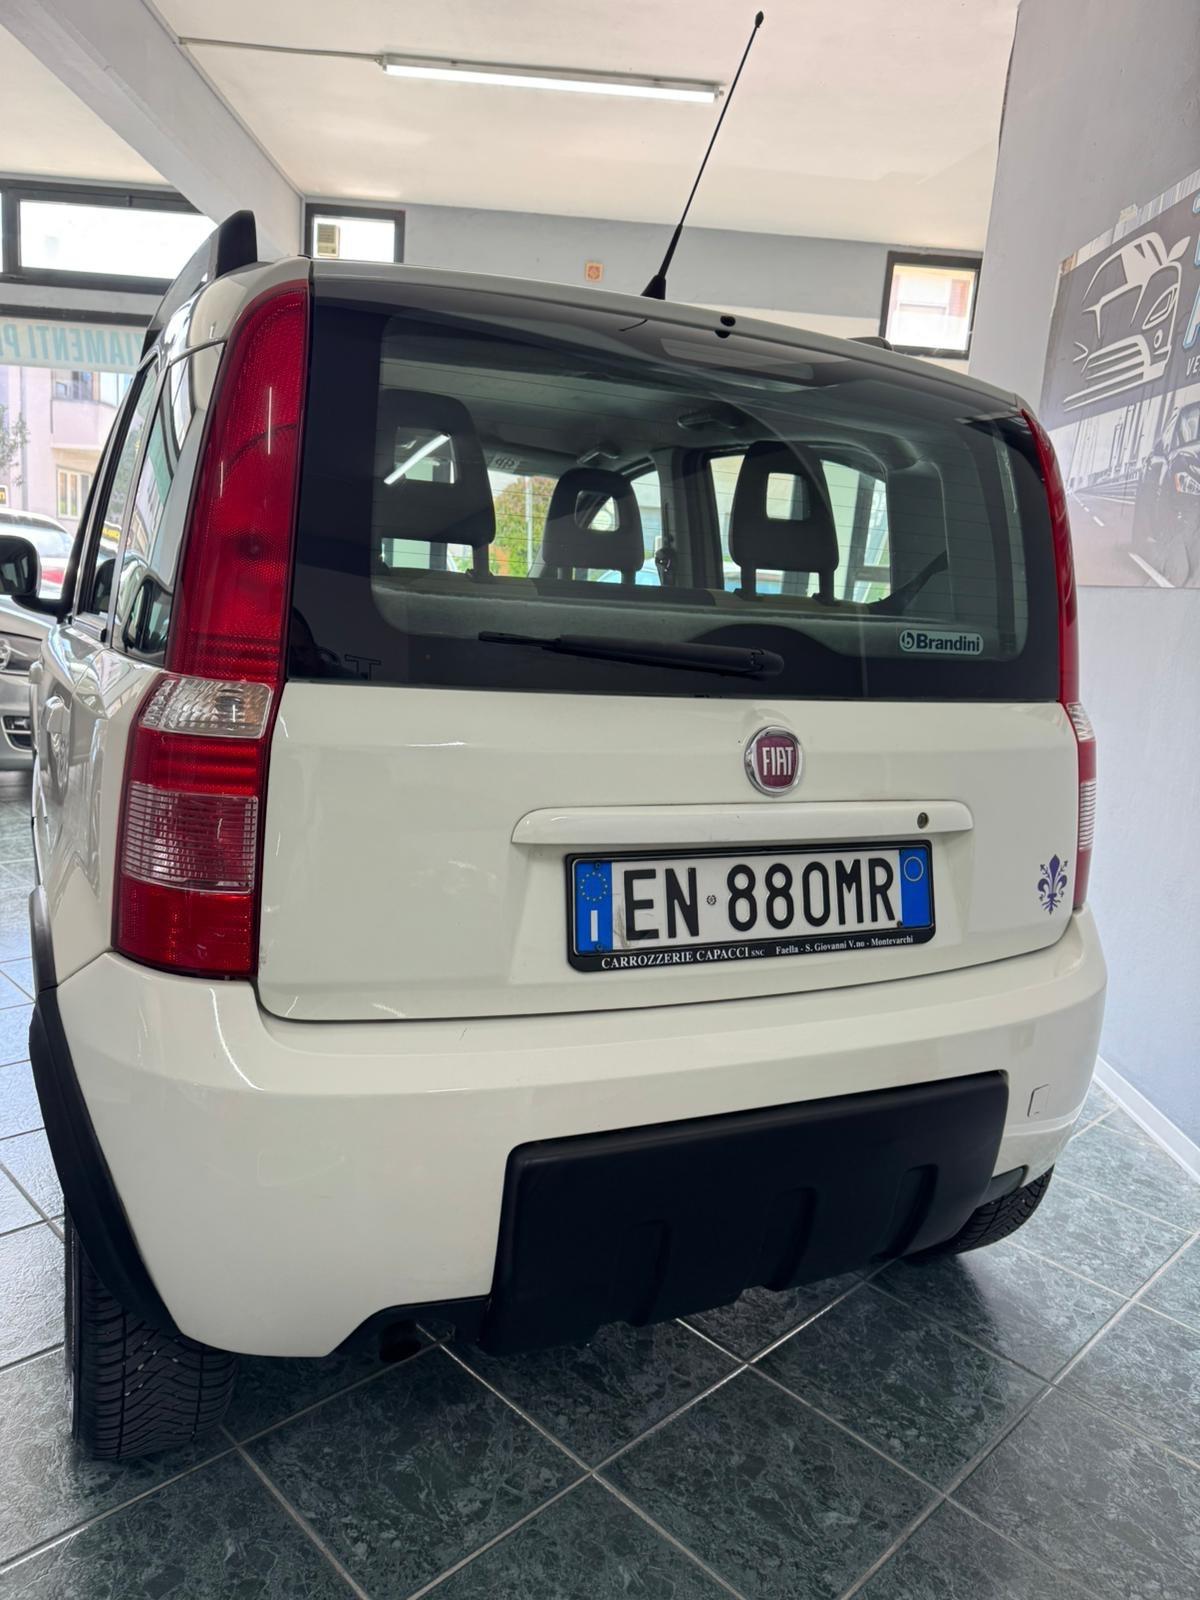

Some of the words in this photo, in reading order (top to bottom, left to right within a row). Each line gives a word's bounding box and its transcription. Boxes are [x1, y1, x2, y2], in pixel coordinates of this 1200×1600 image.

[916, 633, 980, 652] Brandini
[762, 746, 794, 776] FIAT
[623, 867, 700, 941] EN
[726, 857, 896, 932] 880MR
[601, 951, 694, 969] CARROZZERIE
[696, 946, 749, 961] CAPACCI
[775, 945, 799, 956] Faella
[814, 940, 847, 951] Giovanni
[871, 935, 914, 947] Montevarchi
